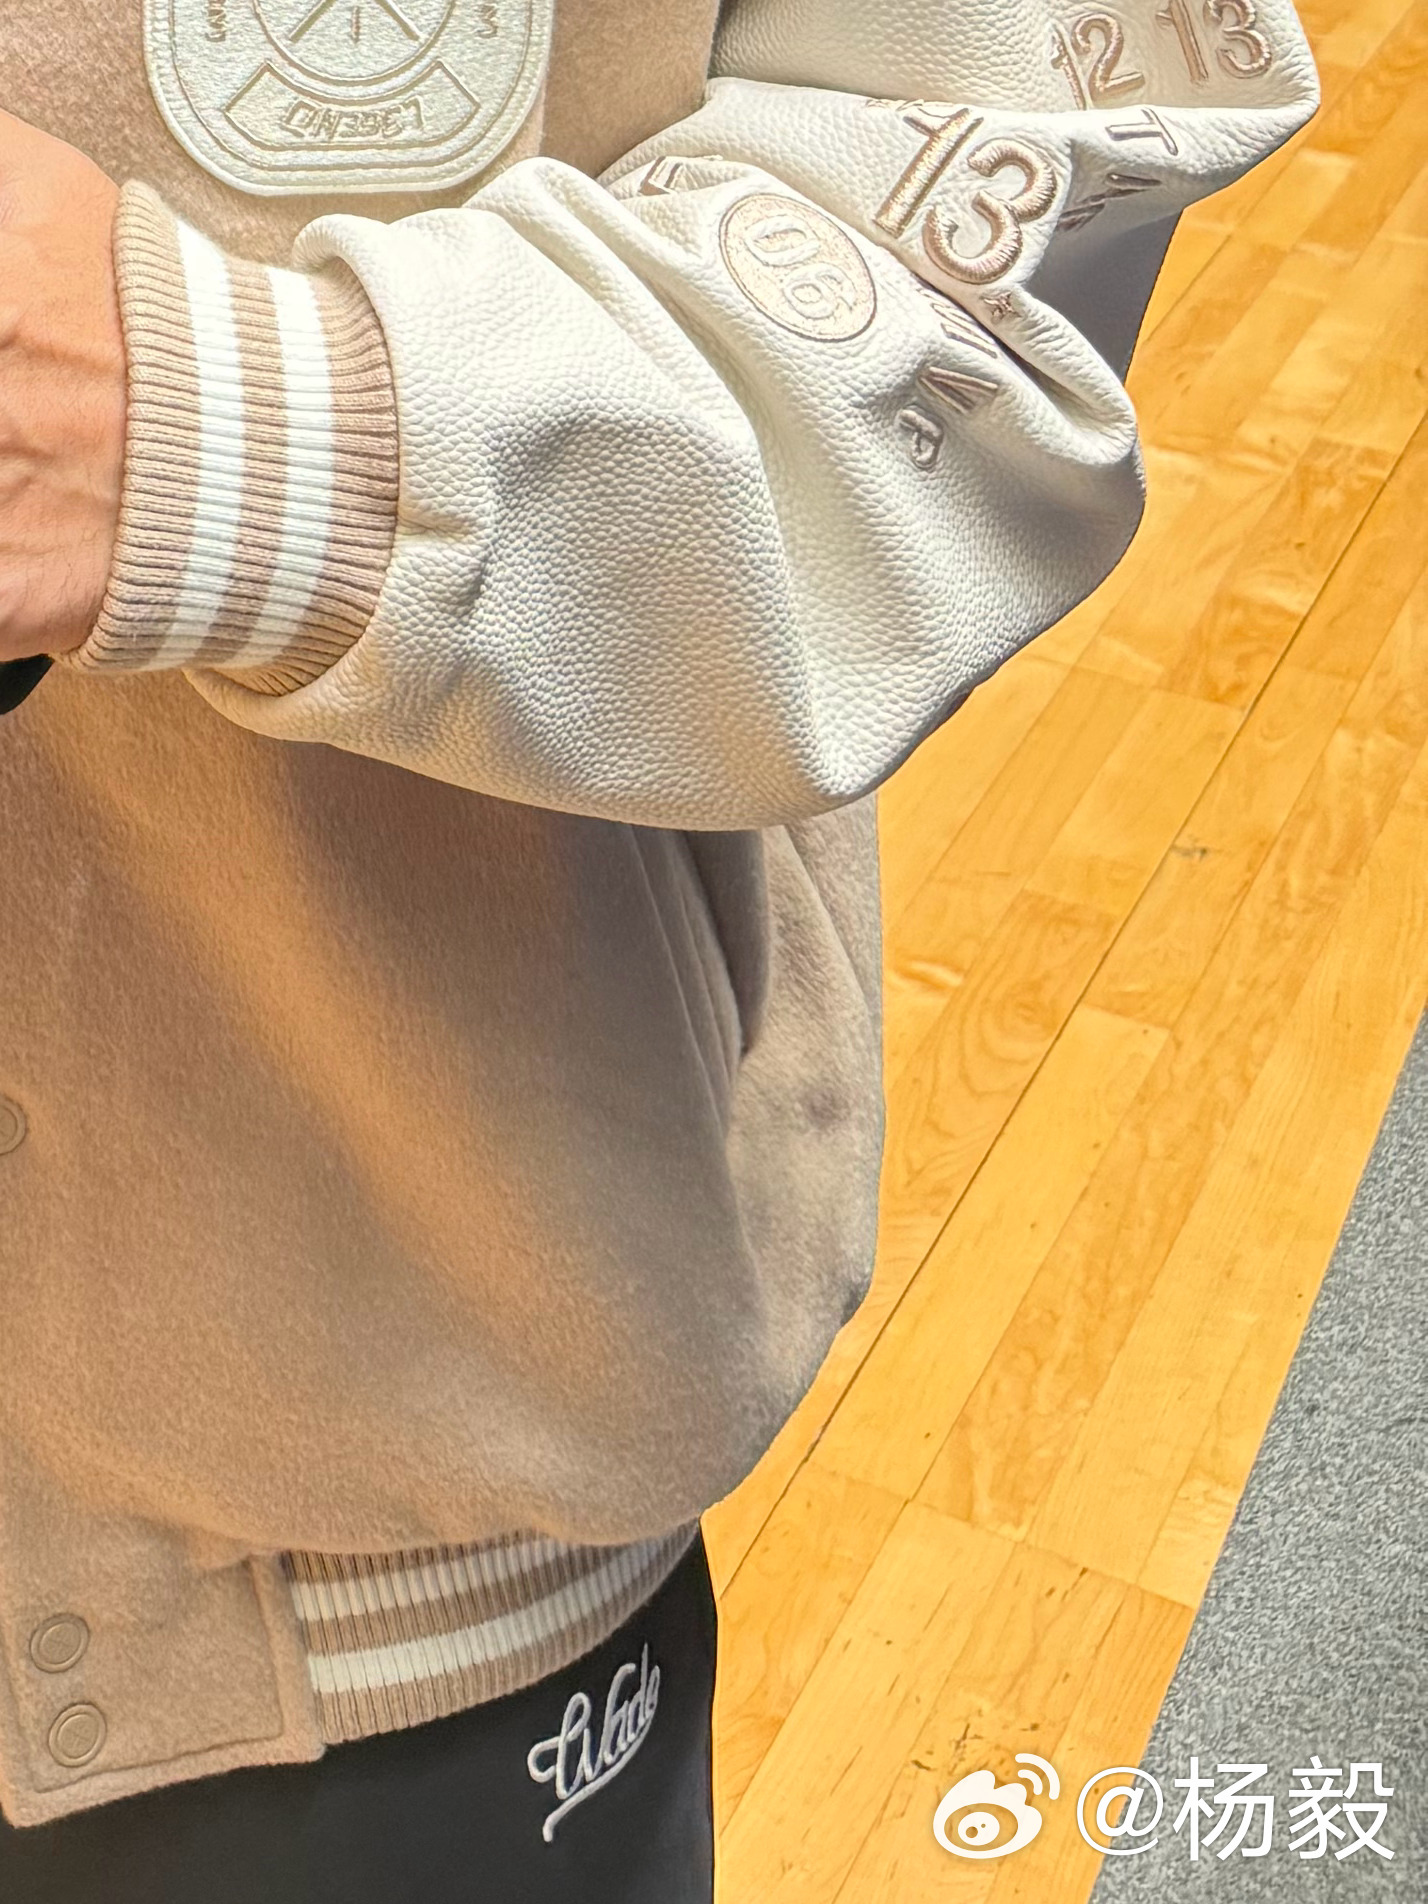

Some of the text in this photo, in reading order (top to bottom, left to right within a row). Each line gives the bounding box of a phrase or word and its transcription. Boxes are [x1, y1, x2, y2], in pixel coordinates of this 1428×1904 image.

[1050, 12, 1146, 111] 12
[873, 106, 1061, 285] 13
[527, 1642, 661, 1842] Wade
